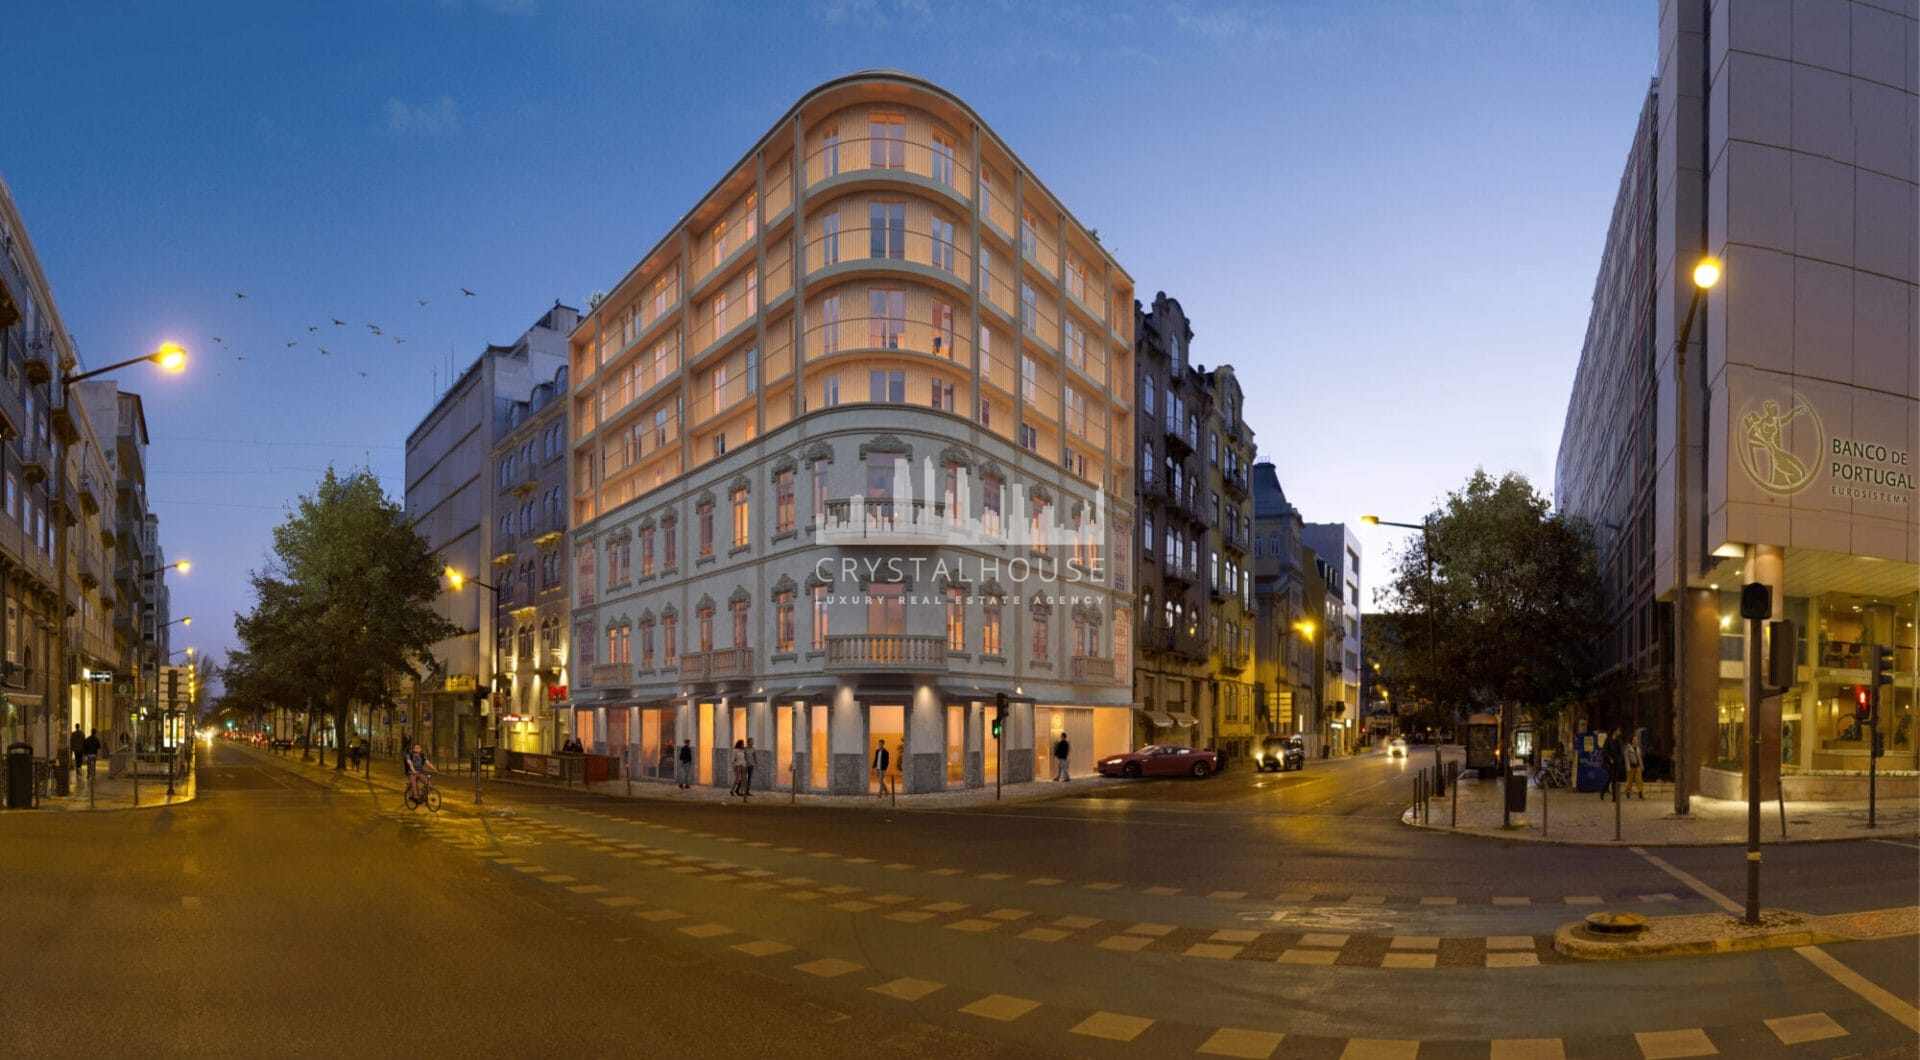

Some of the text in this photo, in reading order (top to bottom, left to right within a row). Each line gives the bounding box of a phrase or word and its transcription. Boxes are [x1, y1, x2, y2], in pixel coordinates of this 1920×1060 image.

[1833, 438, 1908, 465] BANCO DE
[1832, 462, 1916, 490] PORTUGAL
[1832, 486, 1907, 503] EUROSISTEMA
[549, 685, 568, 701] M
